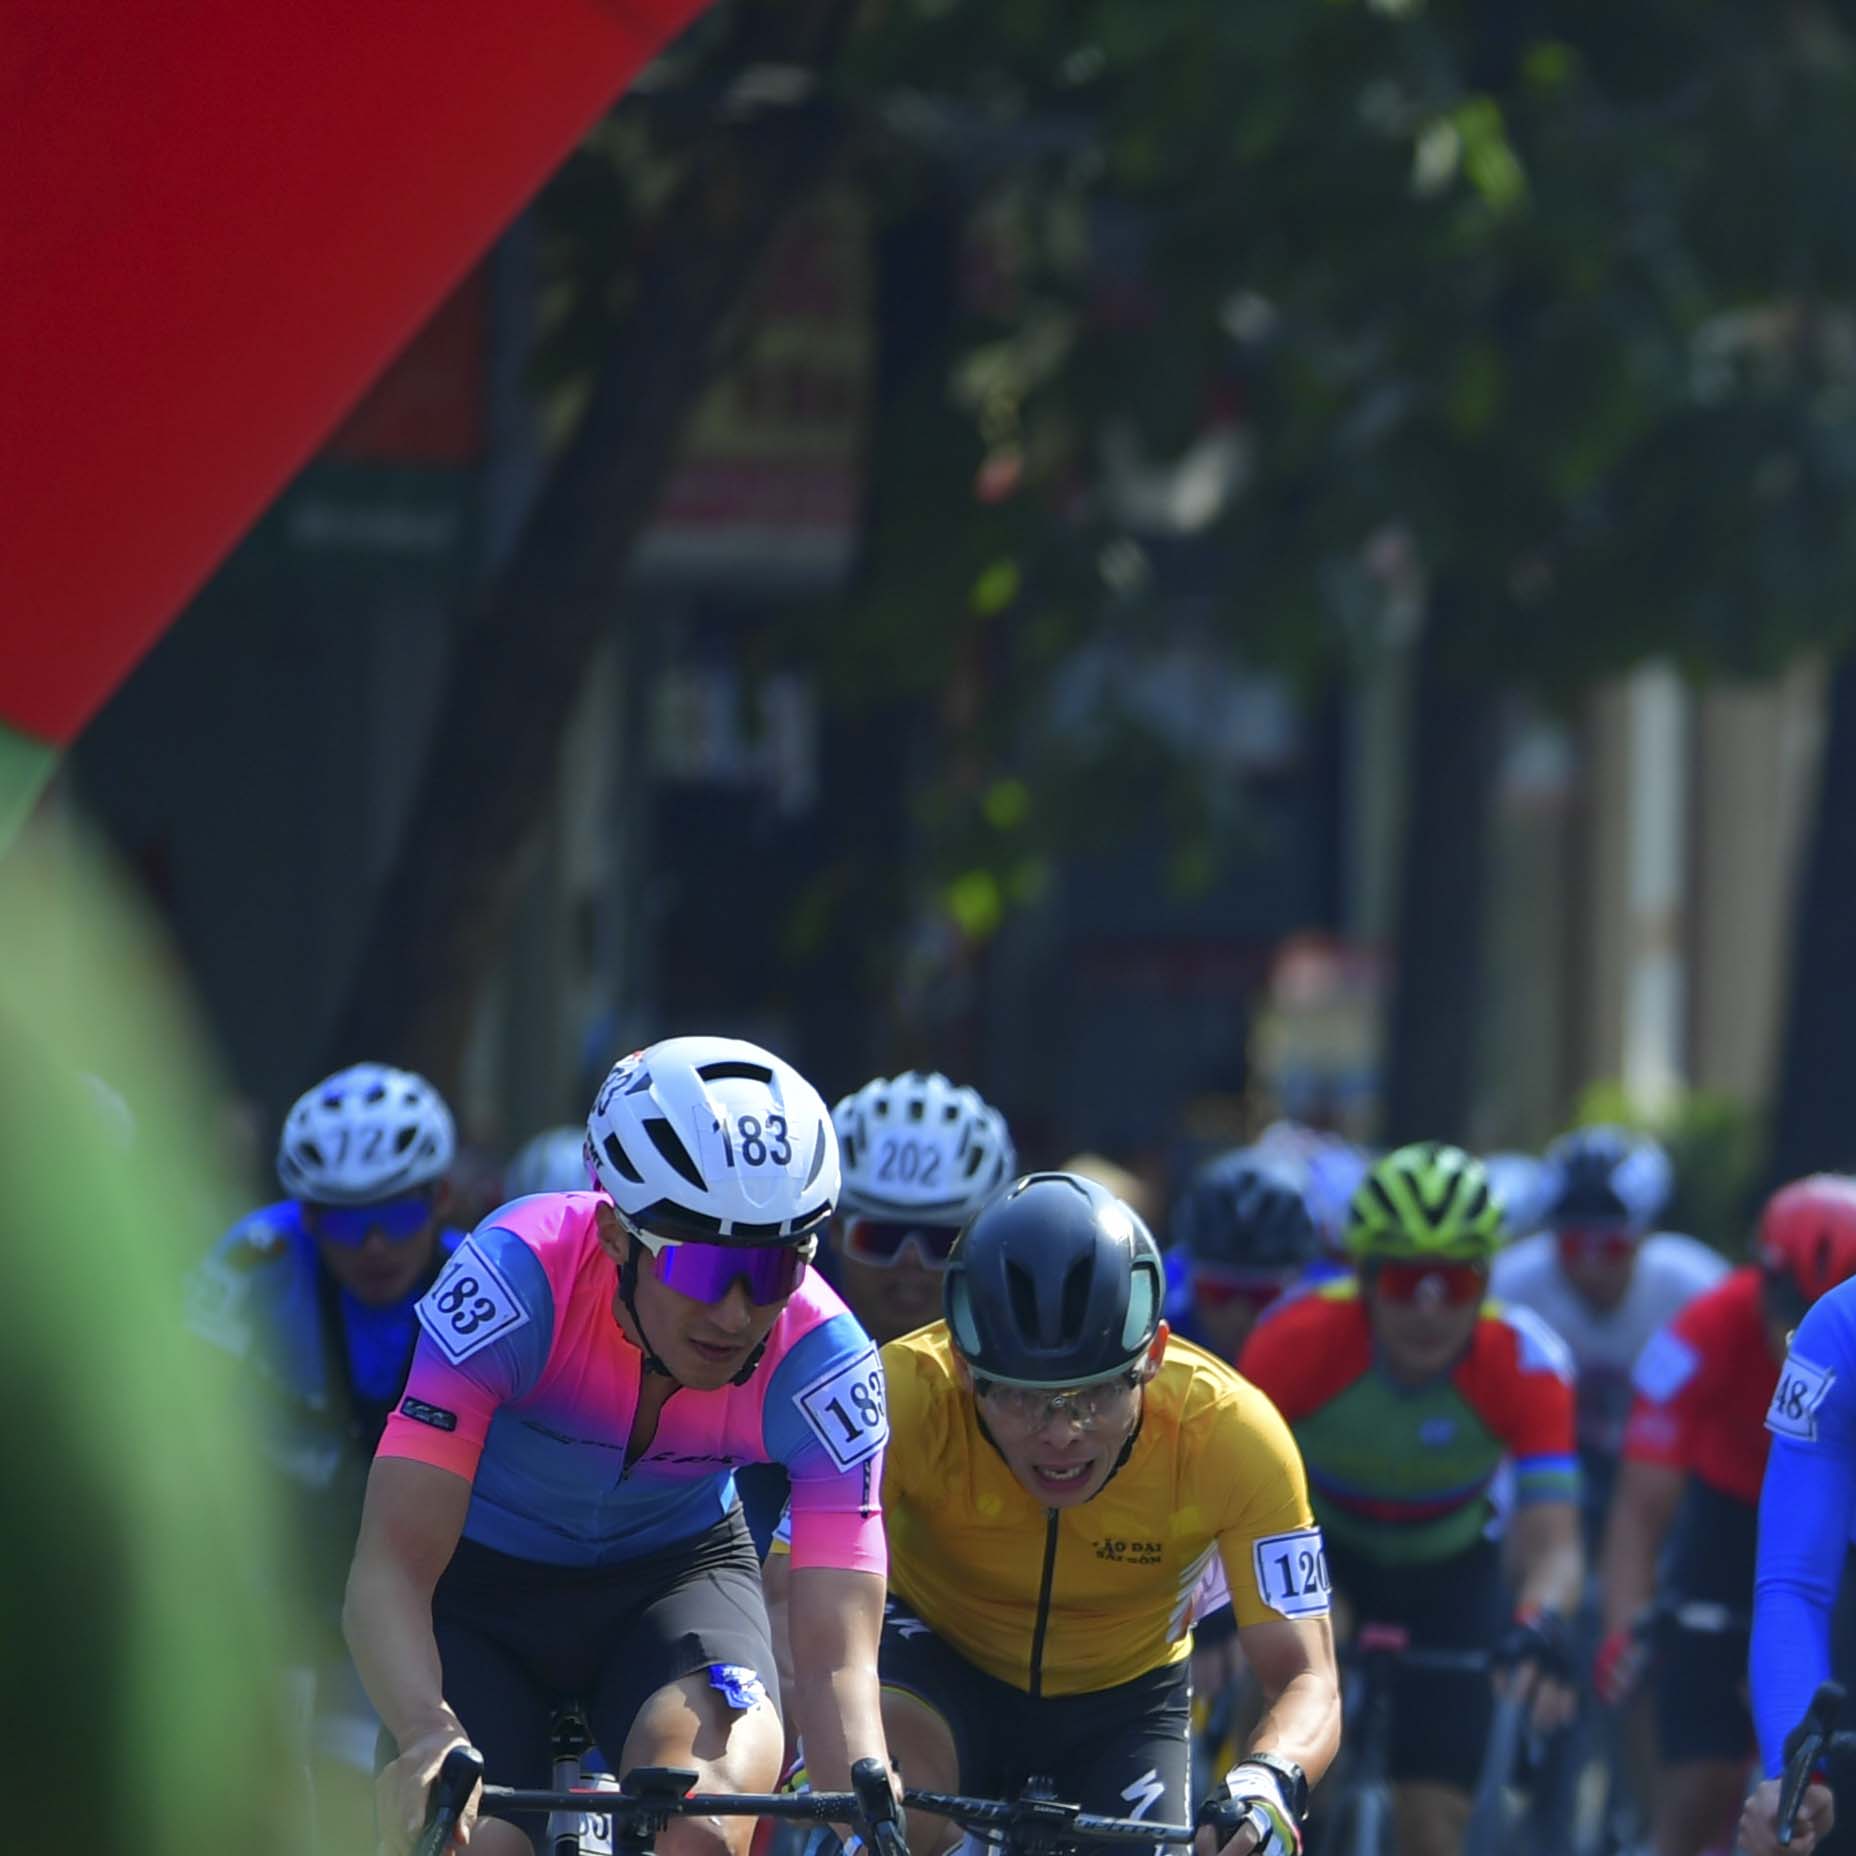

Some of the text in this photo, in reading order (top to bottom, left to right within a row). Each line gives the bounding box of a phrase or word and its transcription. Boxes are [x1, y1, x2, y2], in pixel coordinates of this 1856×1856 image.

[712, 1114, 791, 1167] 183
[878, 1138, 941, 1187] 202
[432, 1263, 497, 1335] 183
